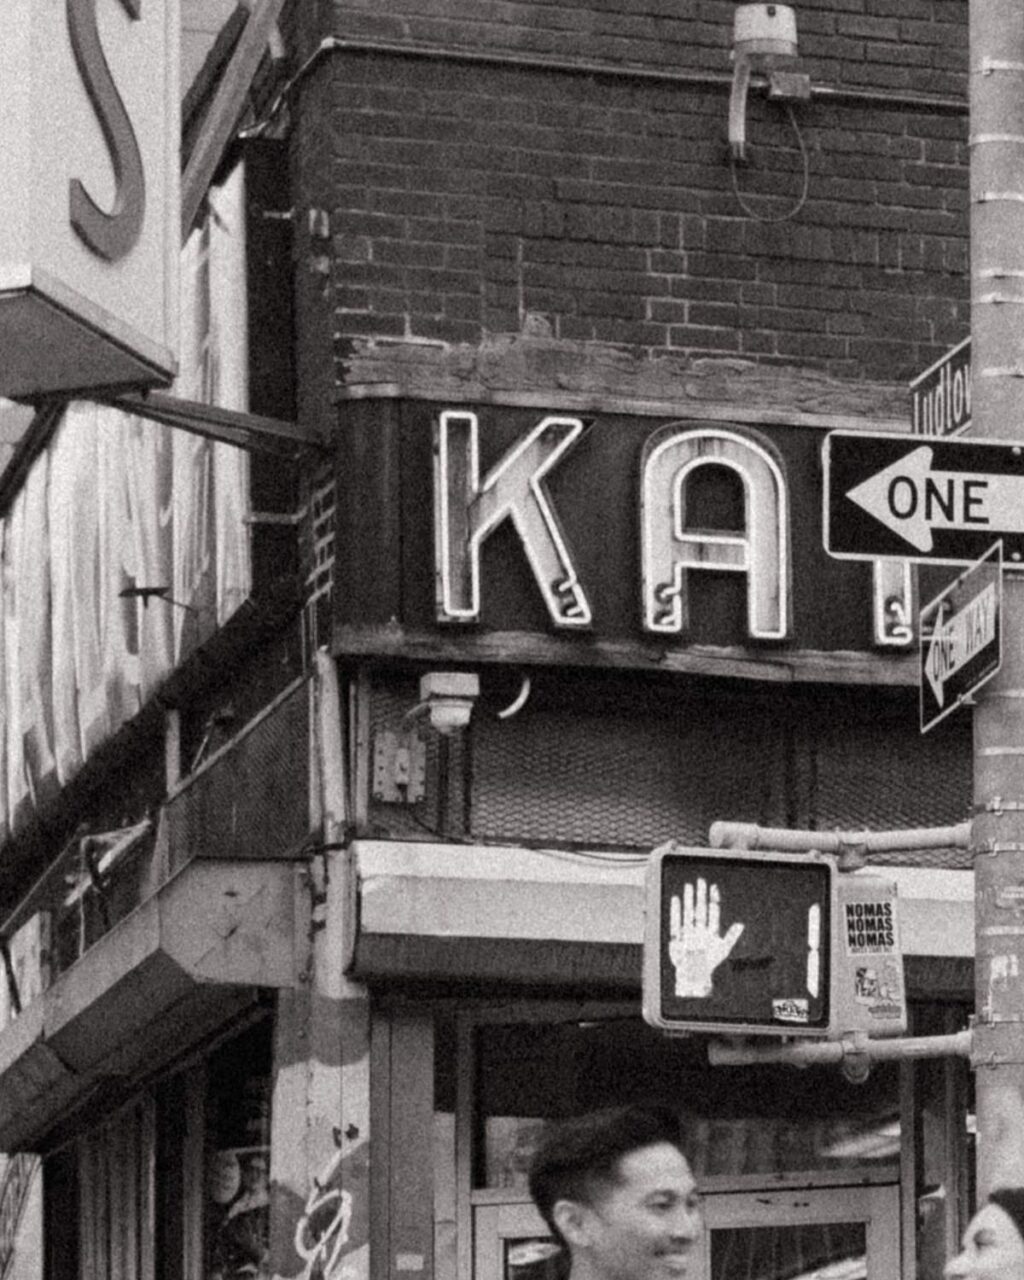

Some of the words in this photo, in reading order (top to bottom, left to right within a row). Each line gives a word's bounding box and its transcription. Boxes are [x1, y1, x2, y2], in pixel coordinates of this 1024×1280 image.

[886, 475, 990, 526] ONE
[845, 902, 892, 918] NOMAS
[847, 917, 893, 932] NOMAS
[848, 932, 894, 947] NOMAS
